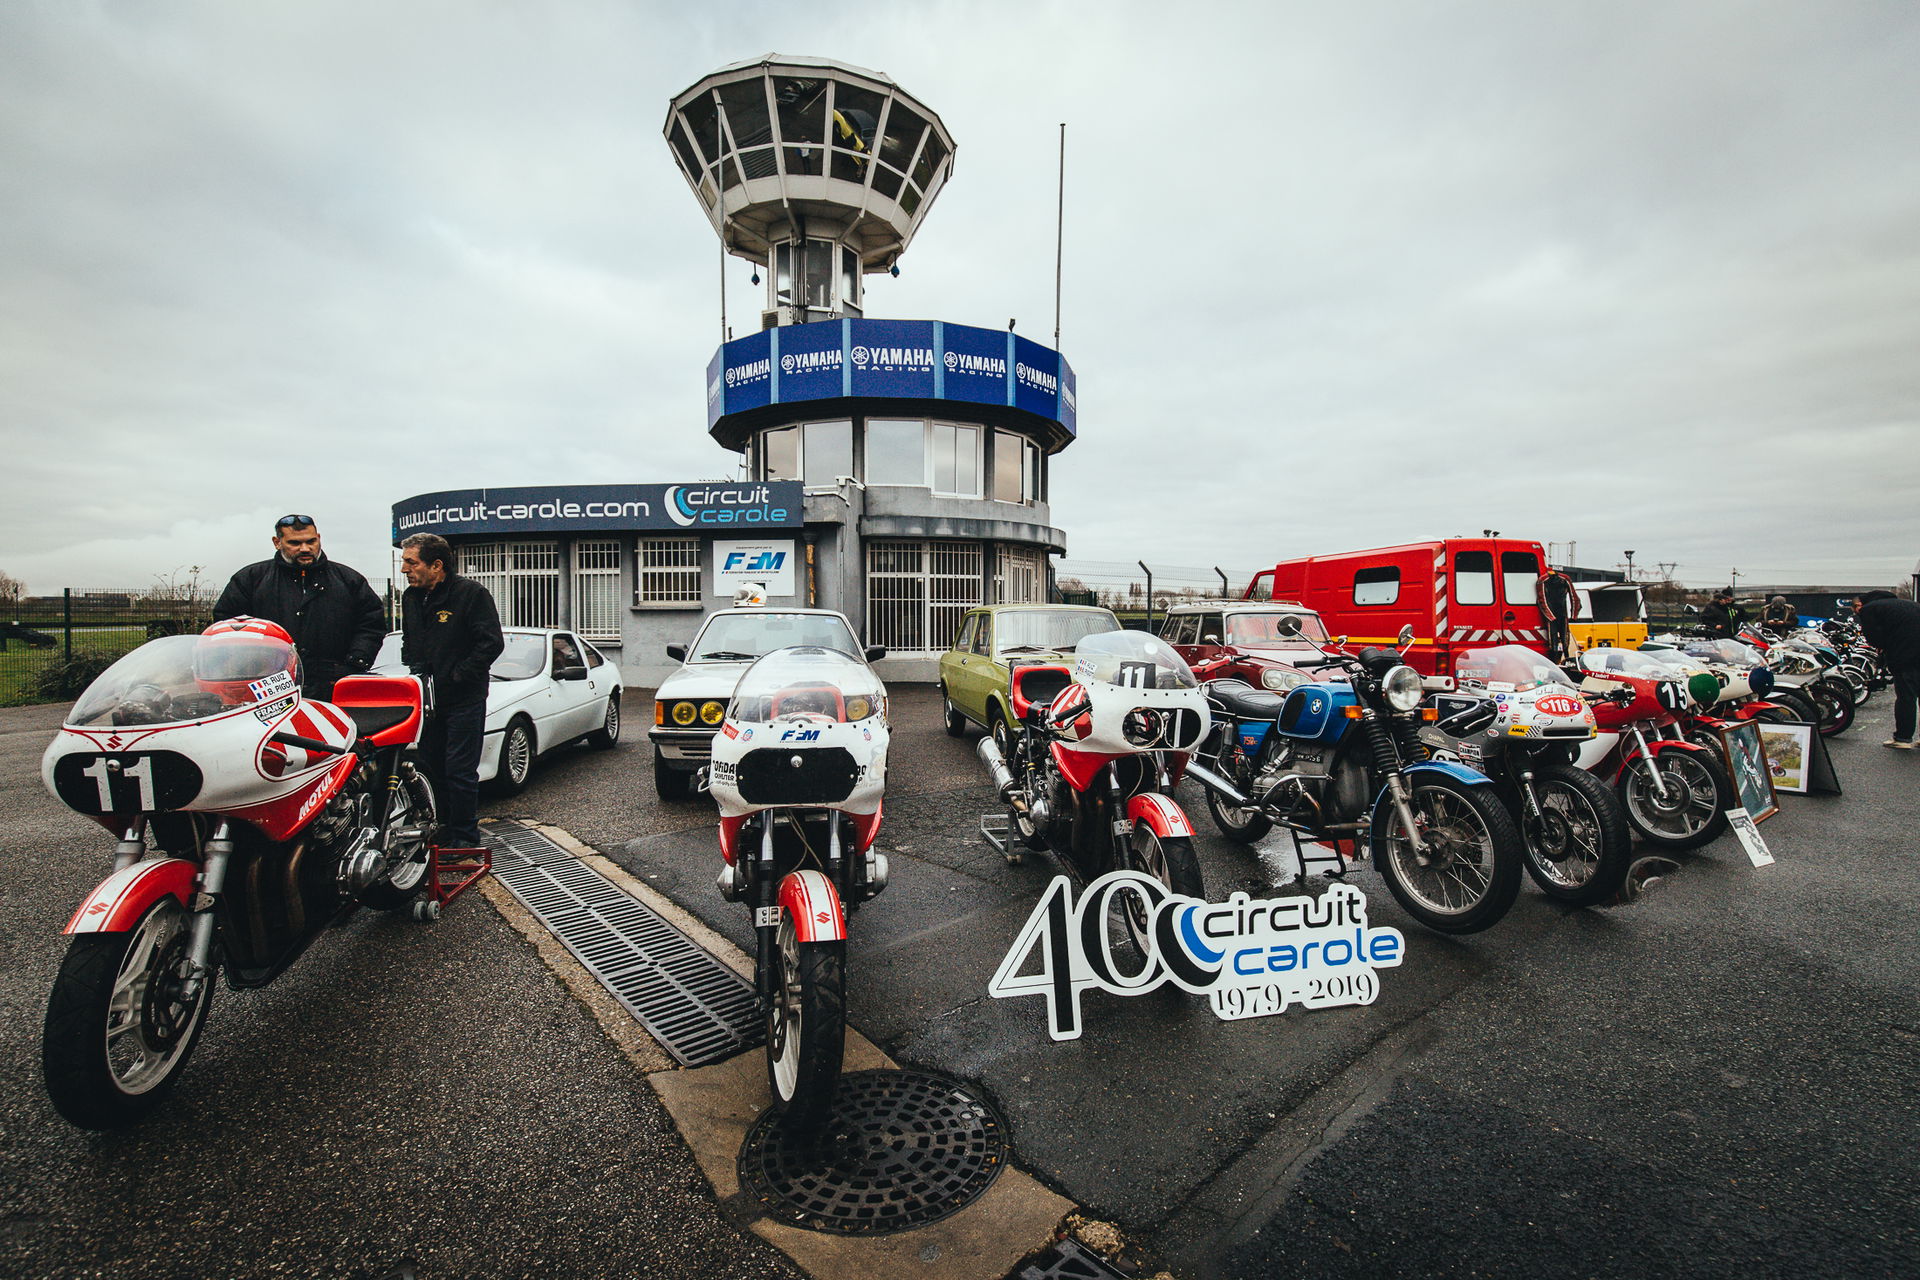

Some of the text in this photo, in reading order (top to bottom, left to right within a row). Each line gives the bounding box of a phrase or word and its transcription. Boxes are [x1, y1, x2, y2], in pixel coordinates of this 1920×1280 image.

[795, 349, 843, 368] YAMAHA
[870, 348, 935, 366] YAMAHA
[958, 354, 1006, 374] YAMAHA
[735, 358, 771, 381] YAMAHA
[786, 365, 840, 375] RACING
[949, 368, 1003, 378] RACING
[1026, 365, 1058, 391] YAMAHA
[729, 374, 769, 388] RACING
[1019, 378, 1056, 395] RACING
[688, 485, 771, 505] circuit
[399, 498, 650, 531] www.circuit-carole.com
[700, 503, 788, 524] carole
[270, 672, 287, 684] RUIZ
[275, 680, 294, 693] PIGOT
[1122, 666, 1146, 689] 11
[1548, 699, 1571, 712] 116
[1661, 682, 1688, 710] 15
[256, 700, 288, 717] FRANCE
[1459, 748, 1480, 757] CHAMPION
[82, 755, 155, 812] 11
[298, 771, 333, 821] MOTUL
[1203, 890, 1362, 939] circuit
[1233, 928, 1400, 976] carole
[1217, 983, 1283, 1017] 1979
[1309, 974, 1374, 1002] 2019
